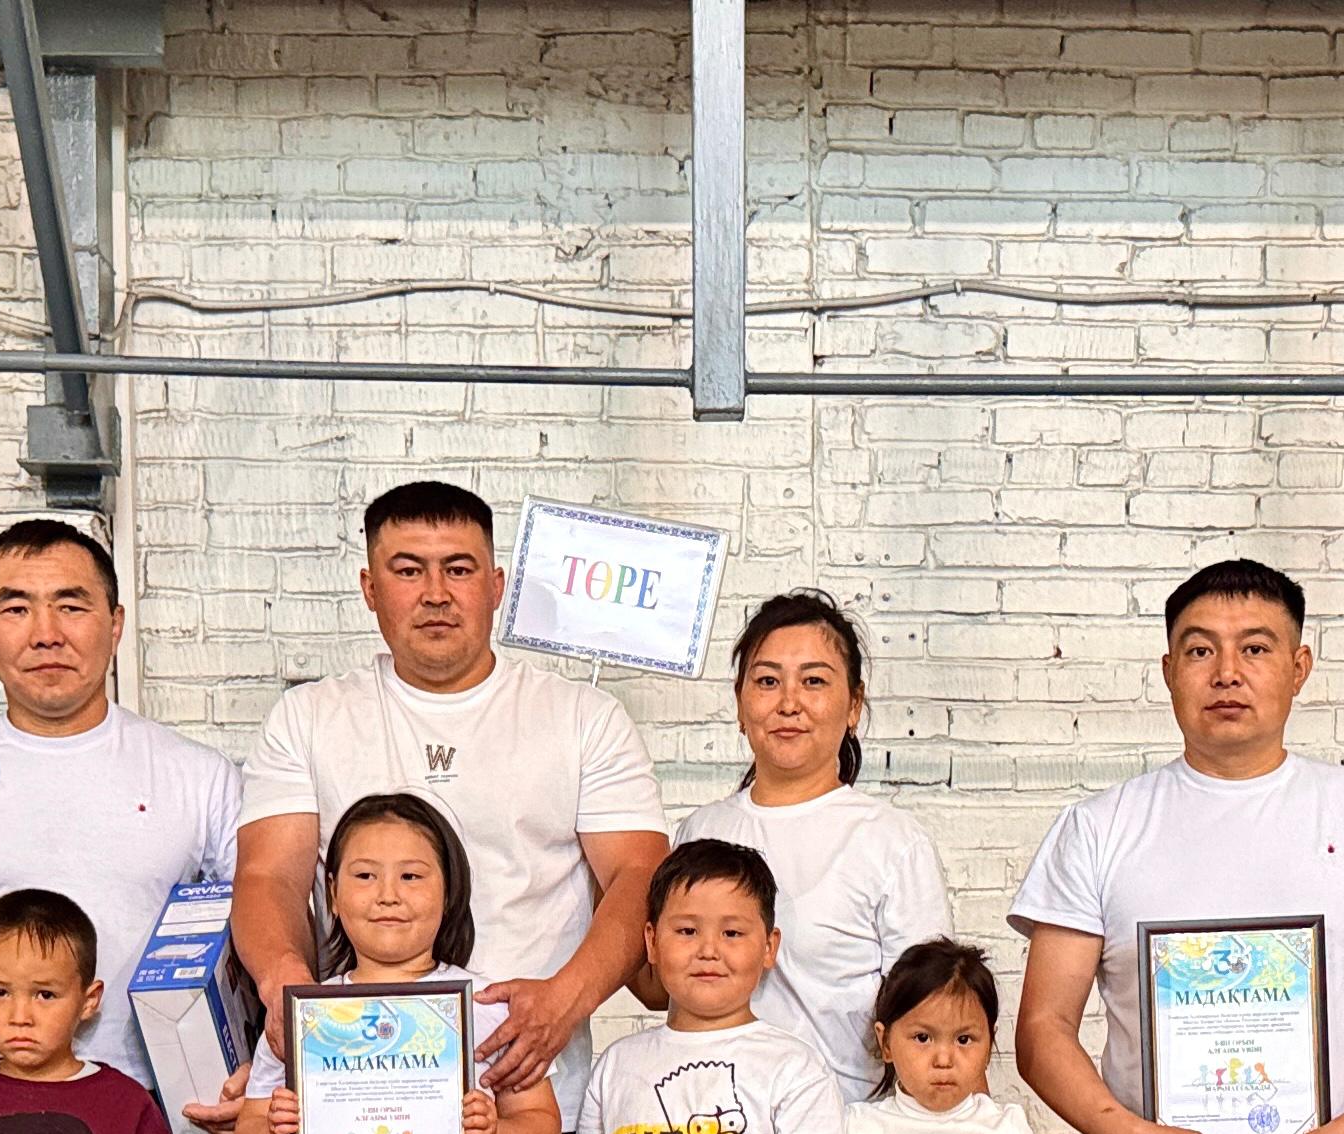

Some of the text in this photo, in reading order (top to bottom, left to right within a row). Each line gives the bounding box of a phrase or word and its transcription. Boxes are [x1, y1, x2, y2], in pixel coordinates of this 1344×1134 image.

[560, 554, 662, 610] ТӨРЕ
[425, 744, 457, 772] W
[1175, 987, 1291, 1008] МАДАҚТАМА
[322, 1052, 440, 1074] МАДАҚТАМА
